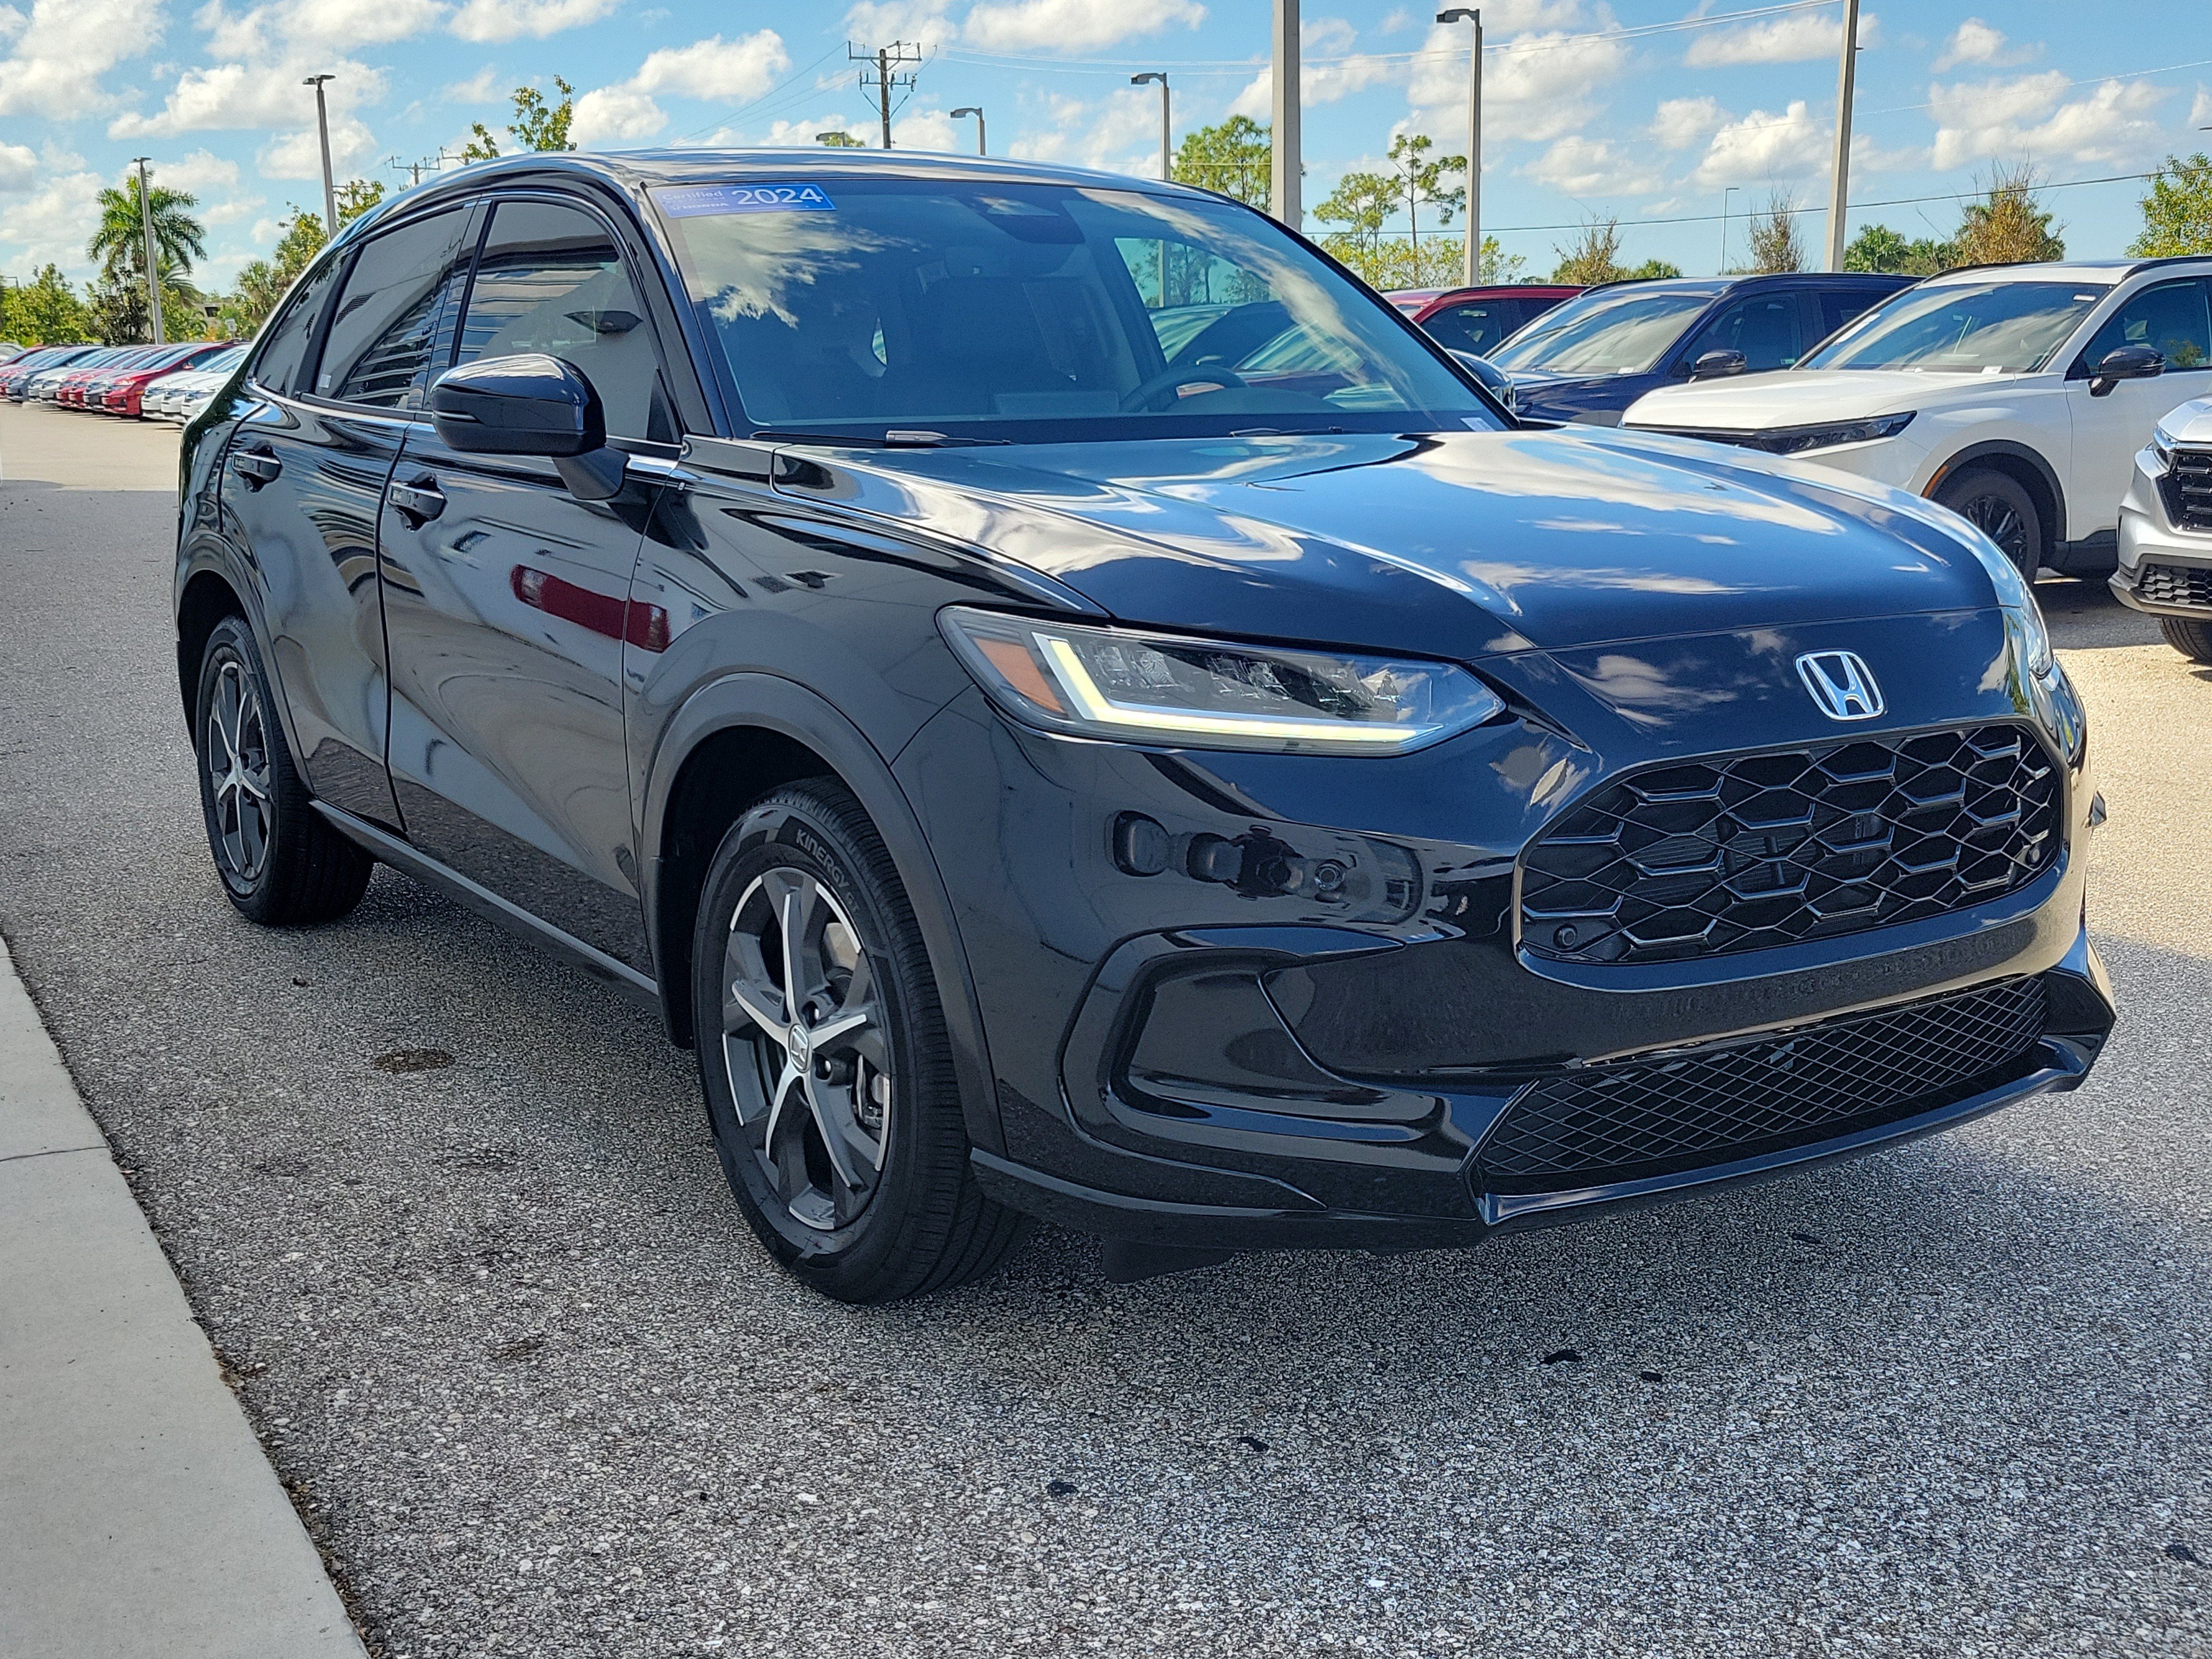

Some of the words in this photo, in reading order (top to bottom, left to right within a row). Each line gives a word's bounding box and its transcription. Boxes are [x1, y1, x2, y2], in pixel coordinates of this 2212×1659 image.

[662, 190, 724, 200] Certified
[731, 188, 823, 205] 2024
[796, 829, 850, 888] KINERGY
